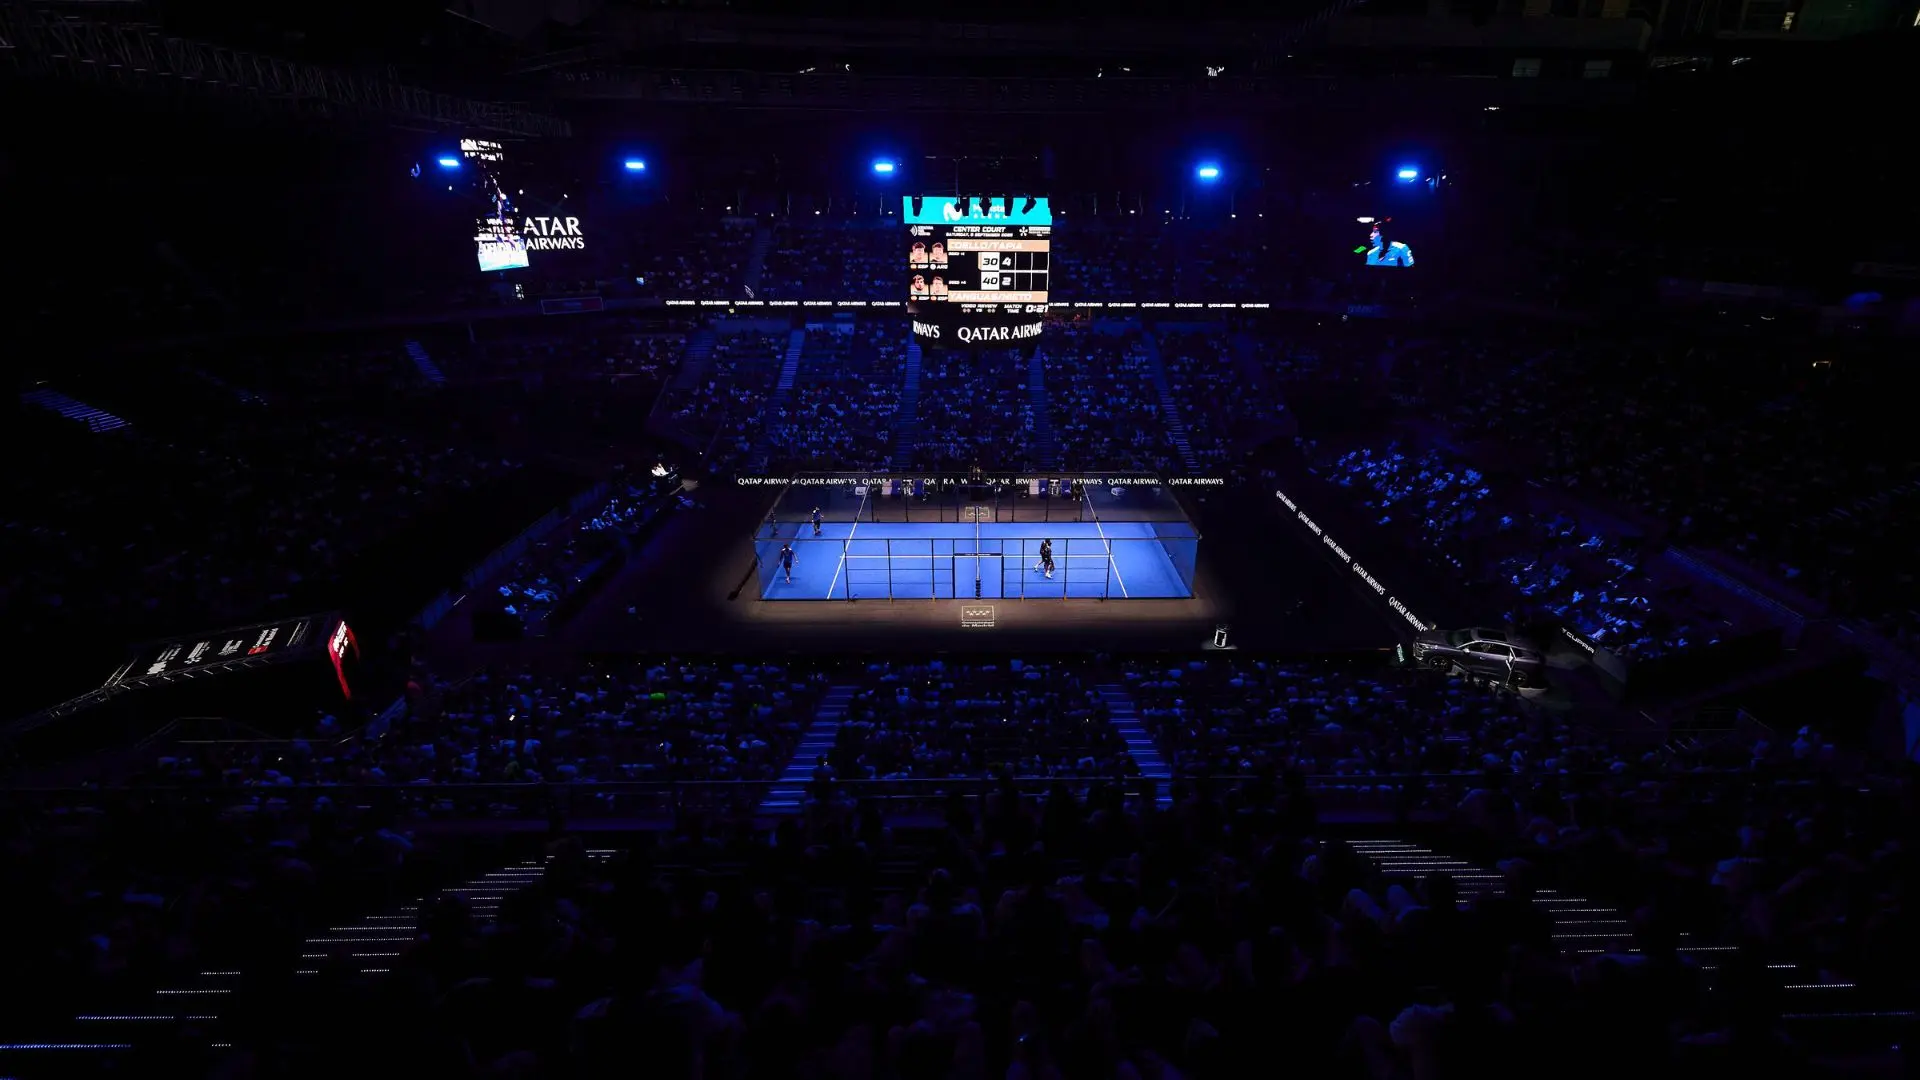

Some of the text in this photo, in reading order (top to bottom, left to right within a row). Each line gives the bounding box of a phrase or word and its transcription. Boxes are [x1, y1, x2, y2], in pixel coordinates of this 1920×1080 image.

[523, 216, 583, 236] ATAR
[525, 236, 585, 250] AIRWAYS
[982, 258, 998, 266] 30
[1002, 257, 1012, 267] 4
[982, 277, 998, 285] 40
[1002, 277, 1011, 286] 2
[1025, 304, 1049, 313] 0:21
[957, 326, 1009, 343] QATAR
[800, 478, 825, 486] QATAR
[1107, 478, 1131, 486] QATAR
[1168, 478, 1192, 486] QATAR
[1352, 562, 1386, 595] QATAR AIRWAYS
[1388, 596, 1407, 615] QATAR
